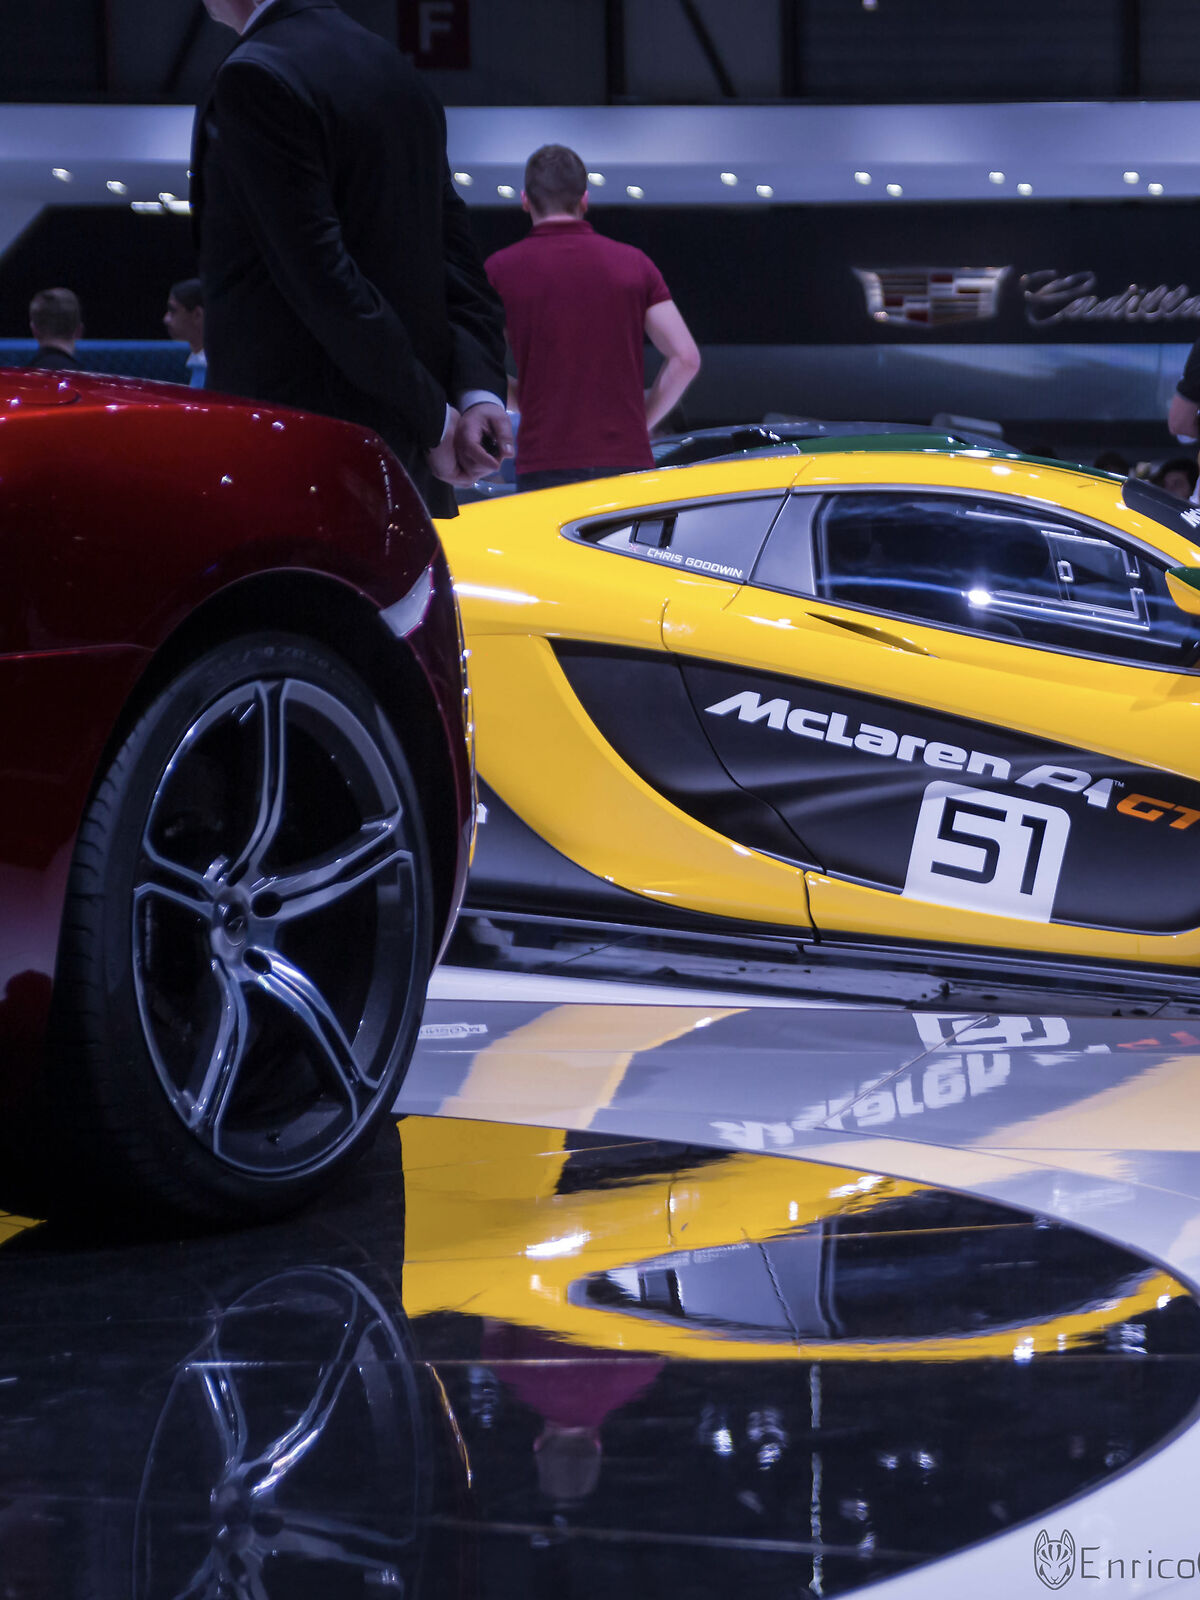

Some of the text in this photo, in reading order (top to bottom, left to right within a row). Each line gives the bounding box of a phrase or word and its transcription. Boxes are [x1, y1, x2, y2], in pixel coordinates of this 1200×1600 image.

[419, 2, 454, 52] F
[646, 547, 743, 578] CHRIS GOODWIN
[704, 691, 1011, 780] McLaren
[930, 796, 1048, 896] 51
